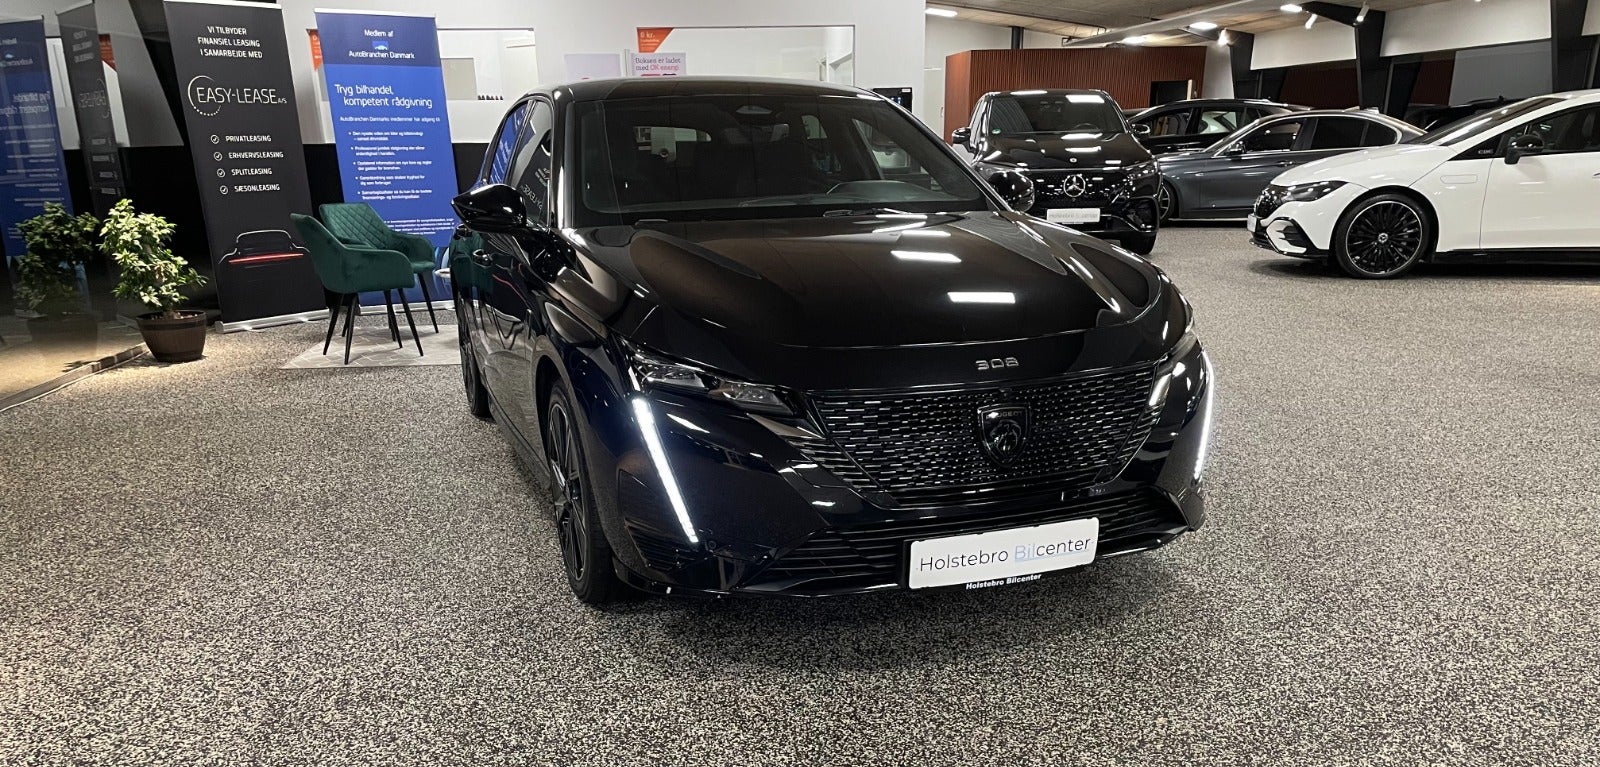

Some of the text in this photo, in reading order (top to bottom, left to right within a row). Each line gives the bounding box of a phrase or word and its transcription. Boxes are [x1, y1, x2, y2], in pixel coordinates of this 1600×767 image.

[216, 26, 247, 35] TILBYDER
[364, 29, 386, 37] Medlem
[198, 37, 260, 47] FINANSIEL LEASING
[204, 49, 247, 58] SAMARBEJDE
[389, 51, 415, 59] Danmark
[334, 84, 394, 96] Tryg bilhandel,
[196, 87, 278, 104] EASY-LEASE
[343, 96, 433, 109] kompetent rådgivning
[228, 151, 284, 159] ERHVERVSLEASING
[231, 167, 273, 176] SPLITLEASING
[234, 184, 280, 192] SÆSONLEASING
[975, 357, 1019, 370] 308
[920, 537, 1091, 572] Holstebro Bilcenter
[965, 573, 1042, 590] Holstebro Bilcenter
